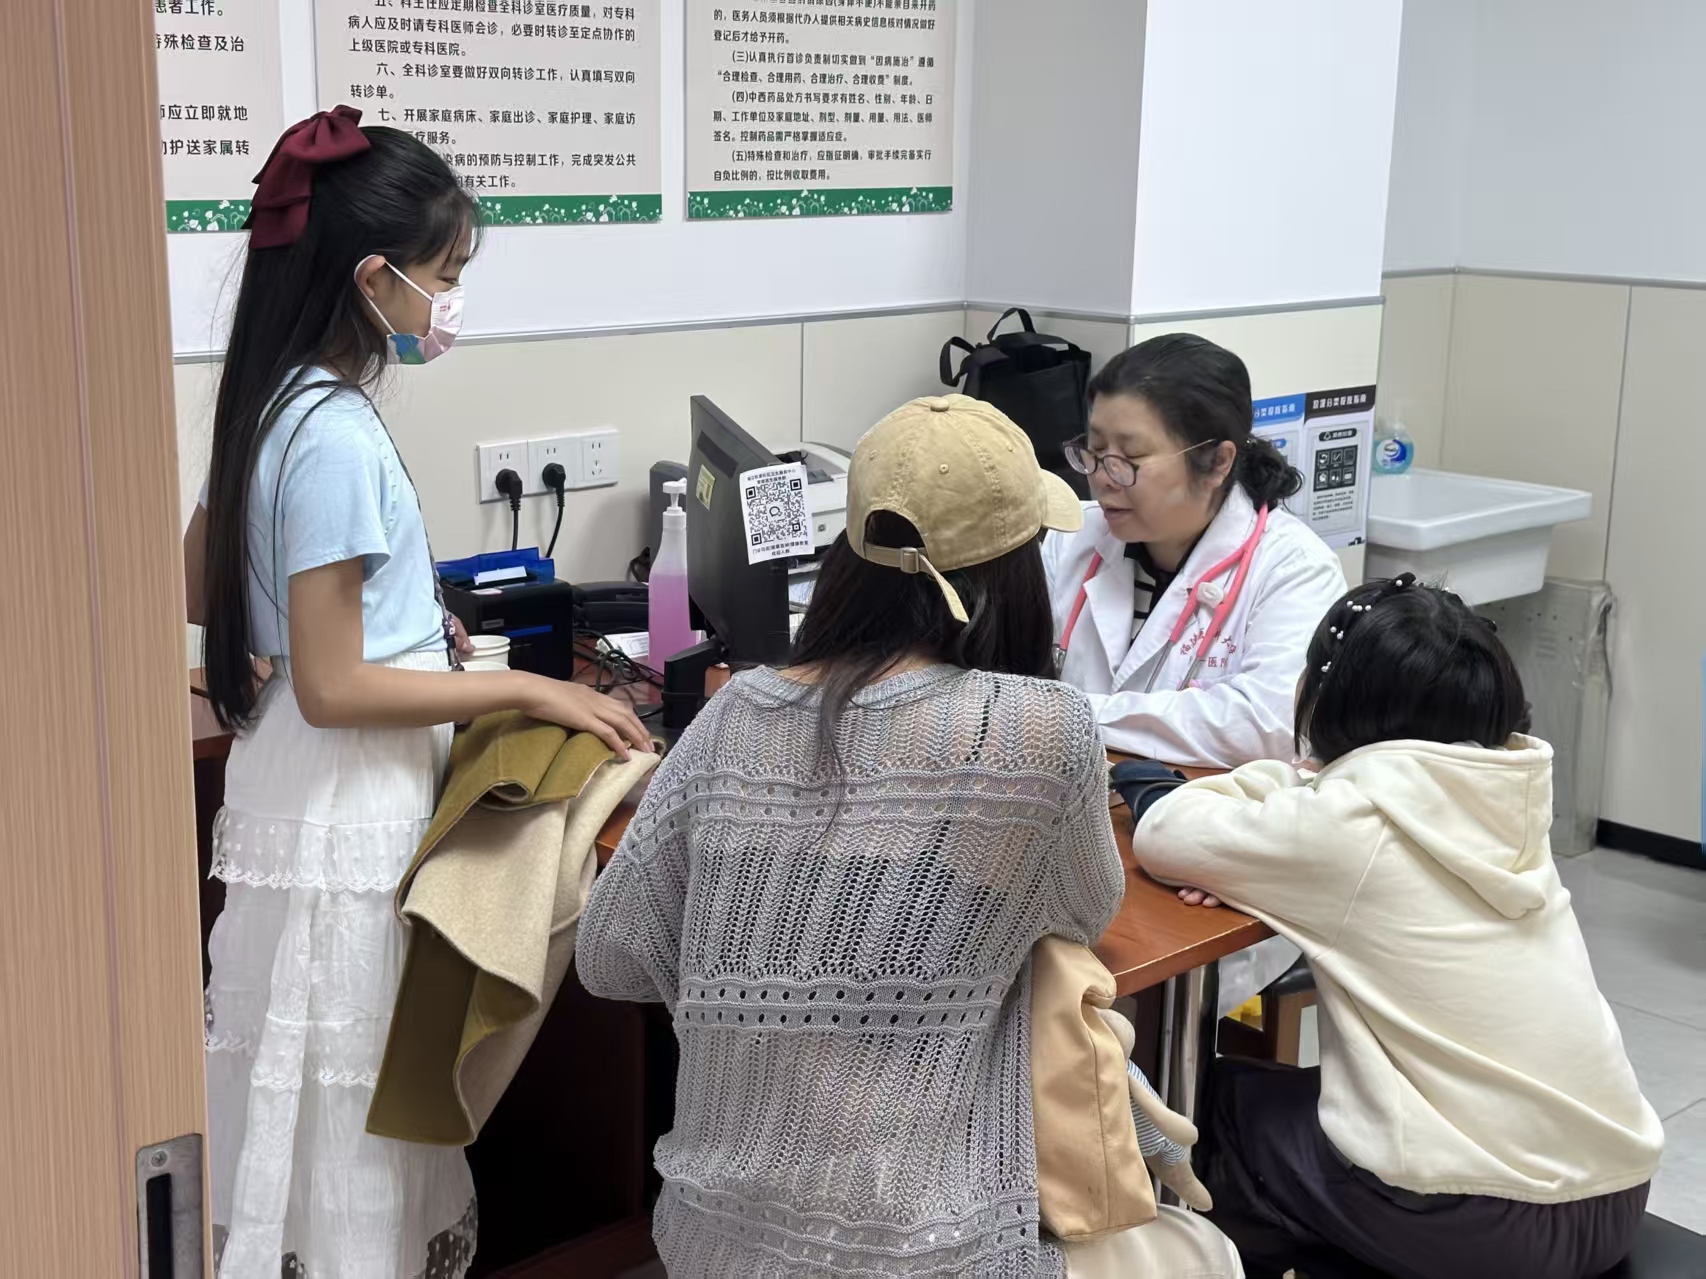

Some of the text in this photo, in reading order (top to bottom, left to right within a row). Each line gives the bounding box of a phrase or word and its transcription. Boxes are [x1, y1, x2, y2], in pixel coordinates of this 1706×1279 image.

[347, 15, 636, 41] 病人应及时请专科医师会诊，必要时转诊至定点协作的
[713, 29, 790, 44] 登记后才给予开药。
[349, 38, 466, 56] 上级医院或专科医院。
[376, 62, 636, 84] 六、全科诊室要做好双向转诊工作，认真填写双向
[350, 84, 394, 99] 转诊单。
[378, 107, 636, 125] 七、开展家庭病床、家庭出诊、家庭护理、家庭访
[406, 130, 457, 145] 疗服务。
